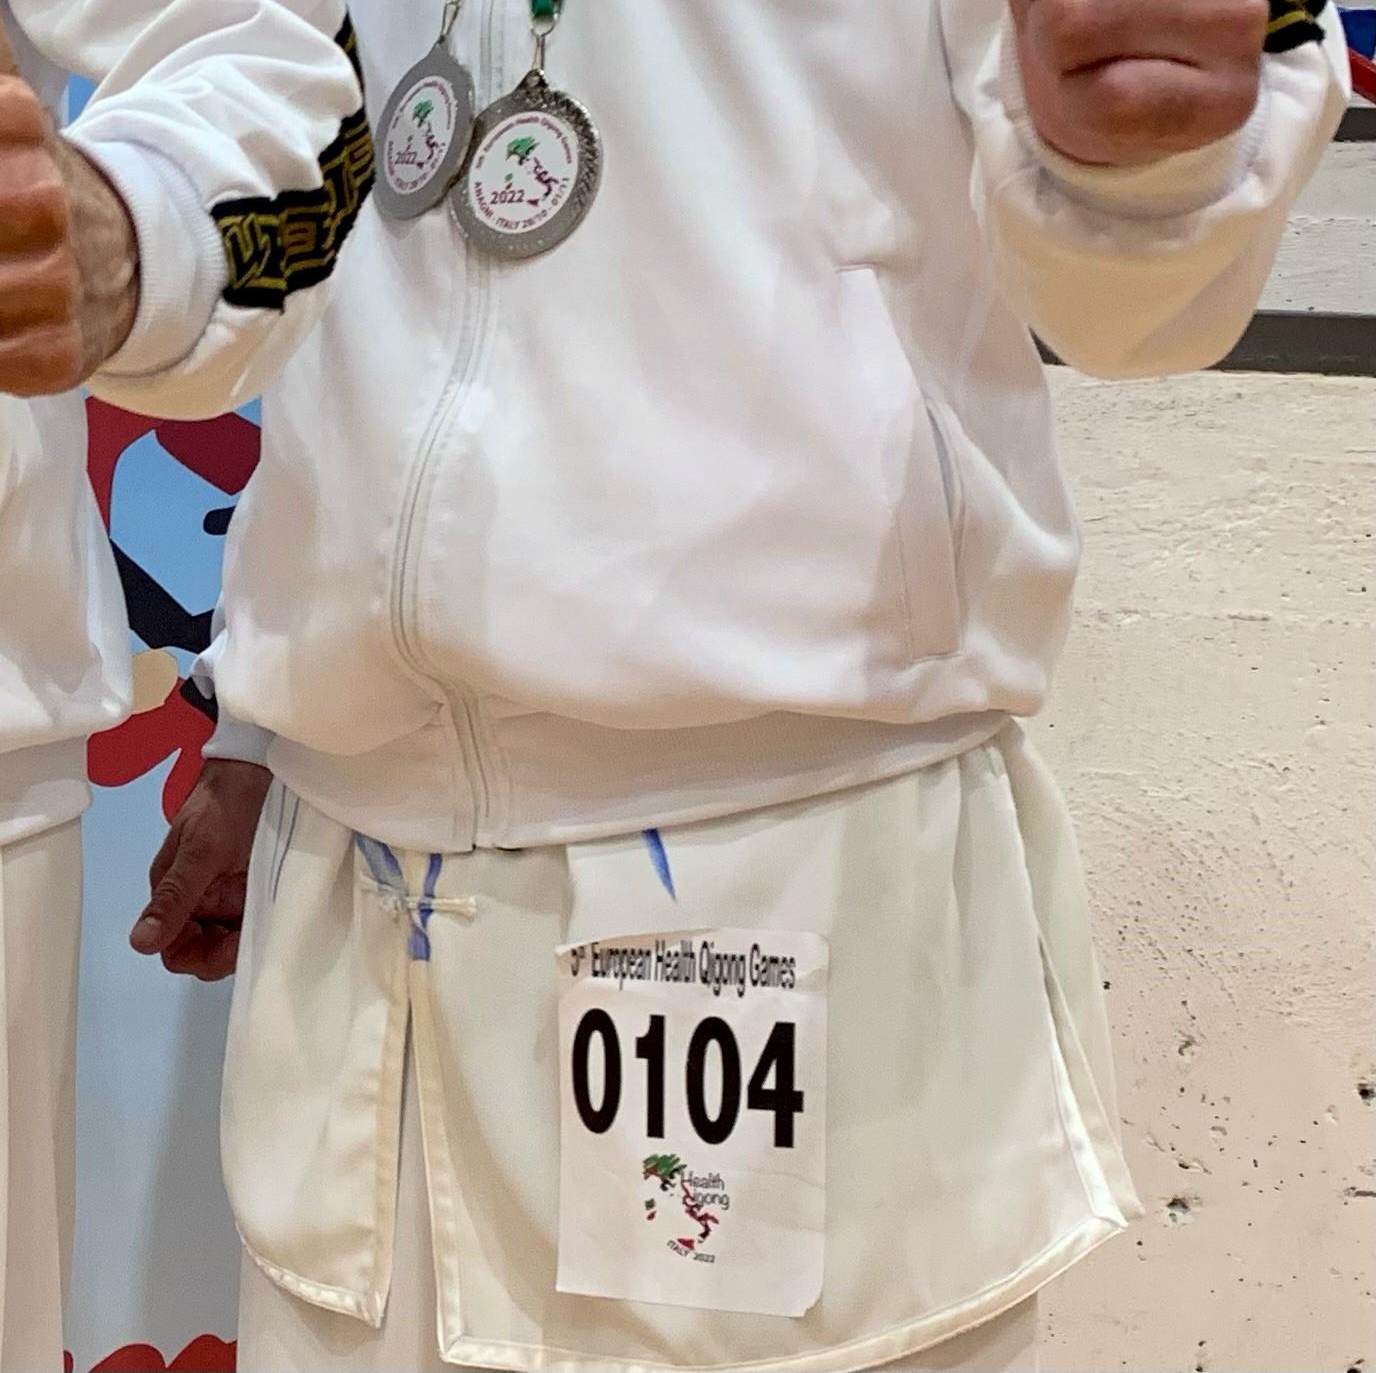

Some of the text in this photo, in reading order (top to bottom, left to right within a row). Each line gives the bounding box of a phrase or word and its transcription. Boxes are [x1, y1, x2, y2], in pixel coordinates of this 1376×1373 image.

[490, 189, 525, 205] 2022
[591, 941, 652, 991] European
[655, 939, 697, 983] Health
[699, 940, 746, 998] Qigong
[749, 942, 797, 989] Games
[571, 1007, 805, 1149] 0104
